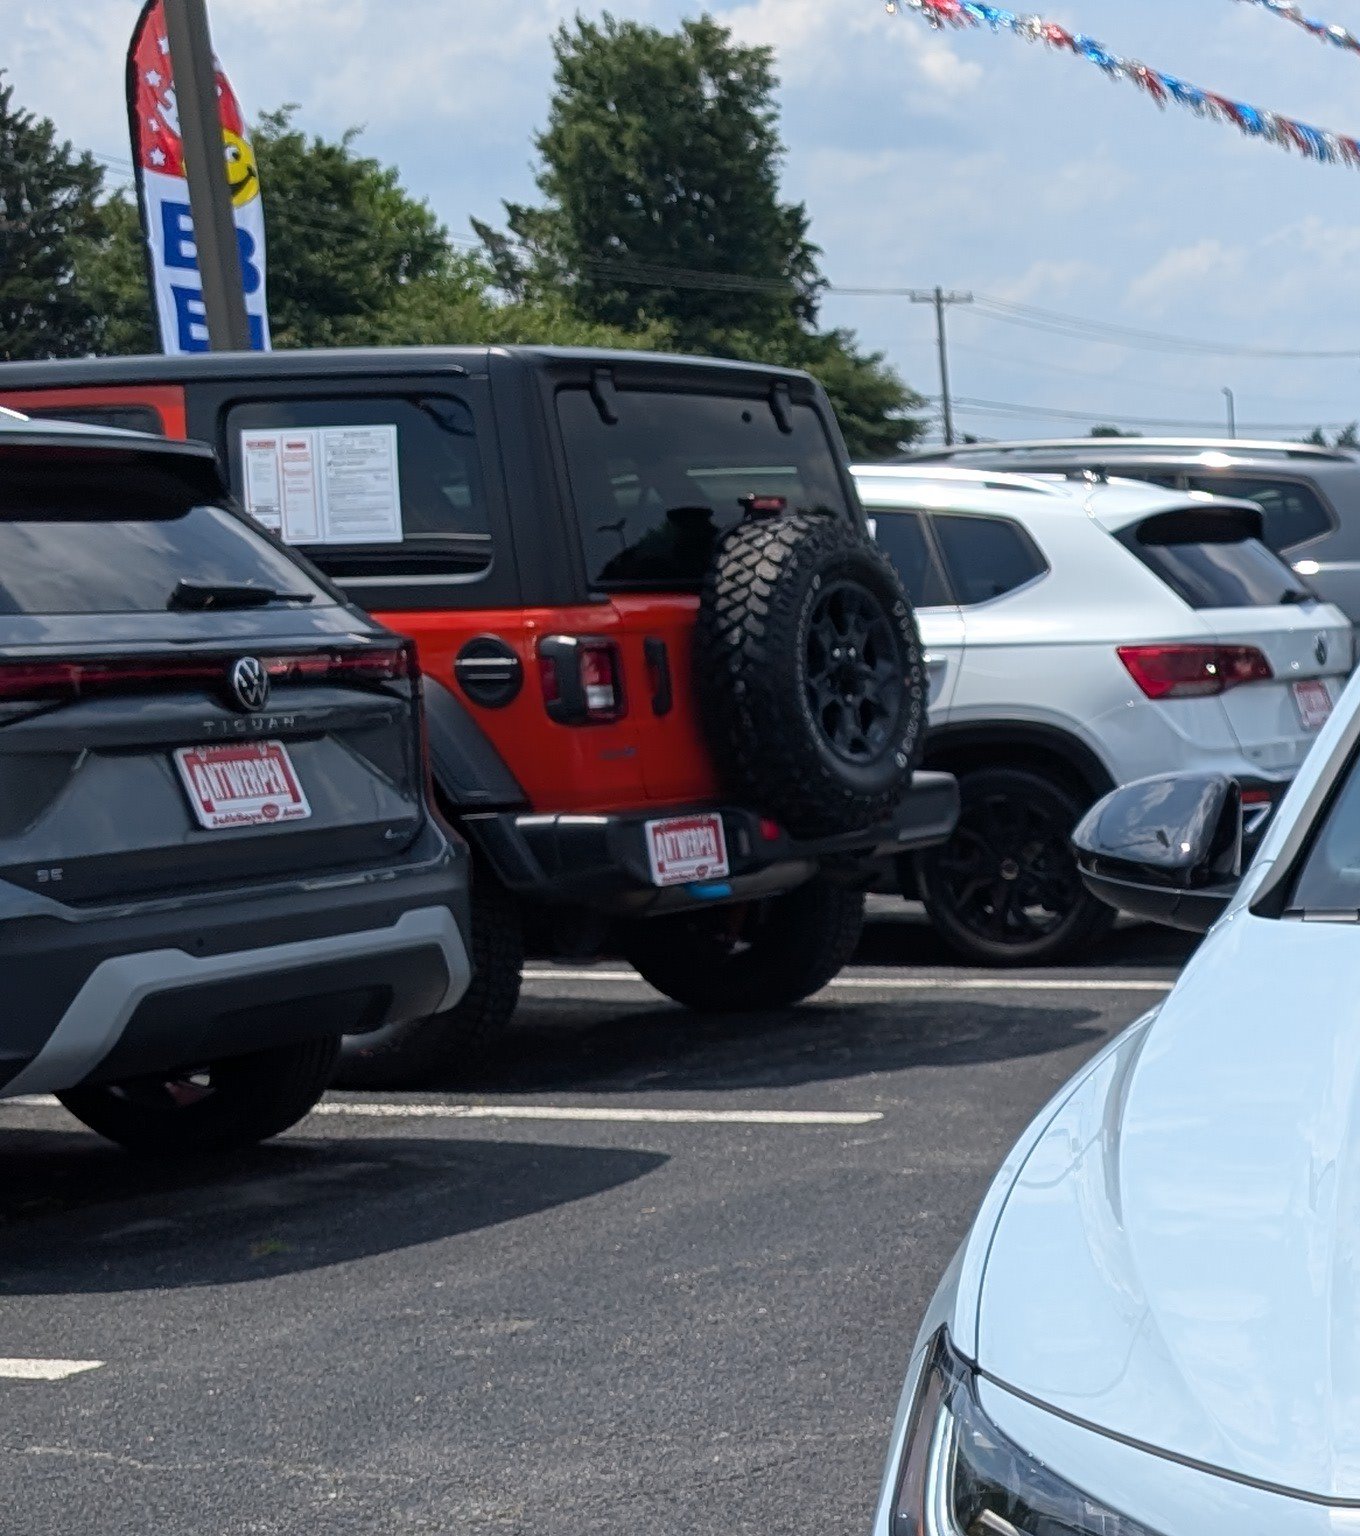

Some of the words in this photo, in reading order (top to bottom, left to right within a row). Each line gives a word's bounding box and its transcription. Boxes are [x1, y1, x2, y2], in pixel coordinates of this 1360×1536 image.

[203, 715, 295, 733] TIGUAN
[193, 756, 291, 801] ANTWERPEN
[655, 826, 718, 862] ANTWERPEN
